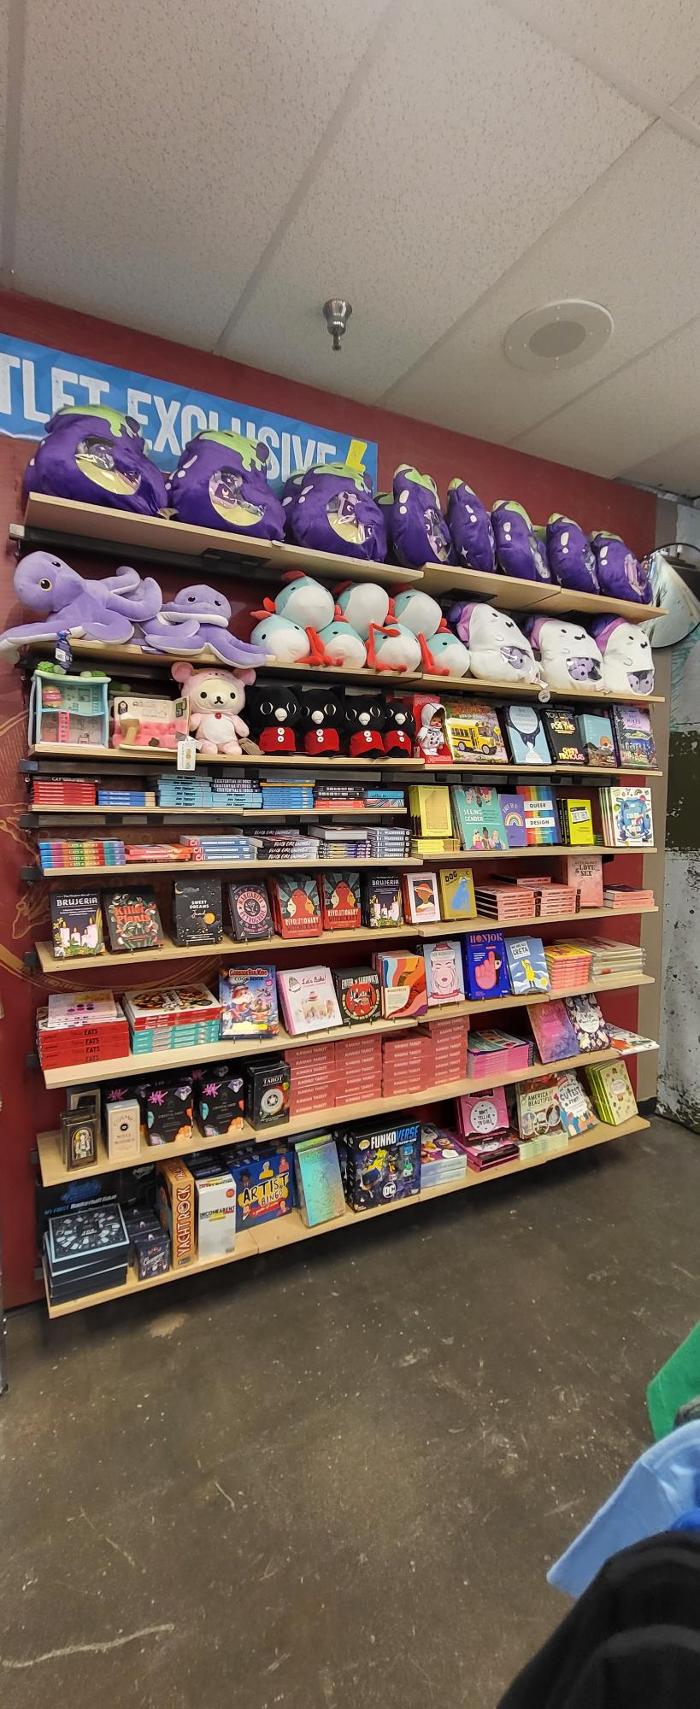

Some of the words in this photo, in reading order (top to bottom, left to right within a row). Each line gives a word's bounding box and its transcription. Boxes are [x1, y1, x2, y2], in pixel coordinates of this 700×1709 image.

[445, 870, 457, 882] DOG
[470, 933, 503, 943] HONJOK
[263, 1076, 283, 1084] TAROT
[528, 1092, 548, 1101] AMERICA
[243, 1172, 289, 1204] ARTIST
[383, 1184, 396, 1196] DC
[177, 1184, 191, 1220] ROCK
[177, 1221, 191, 1257] YACHT
